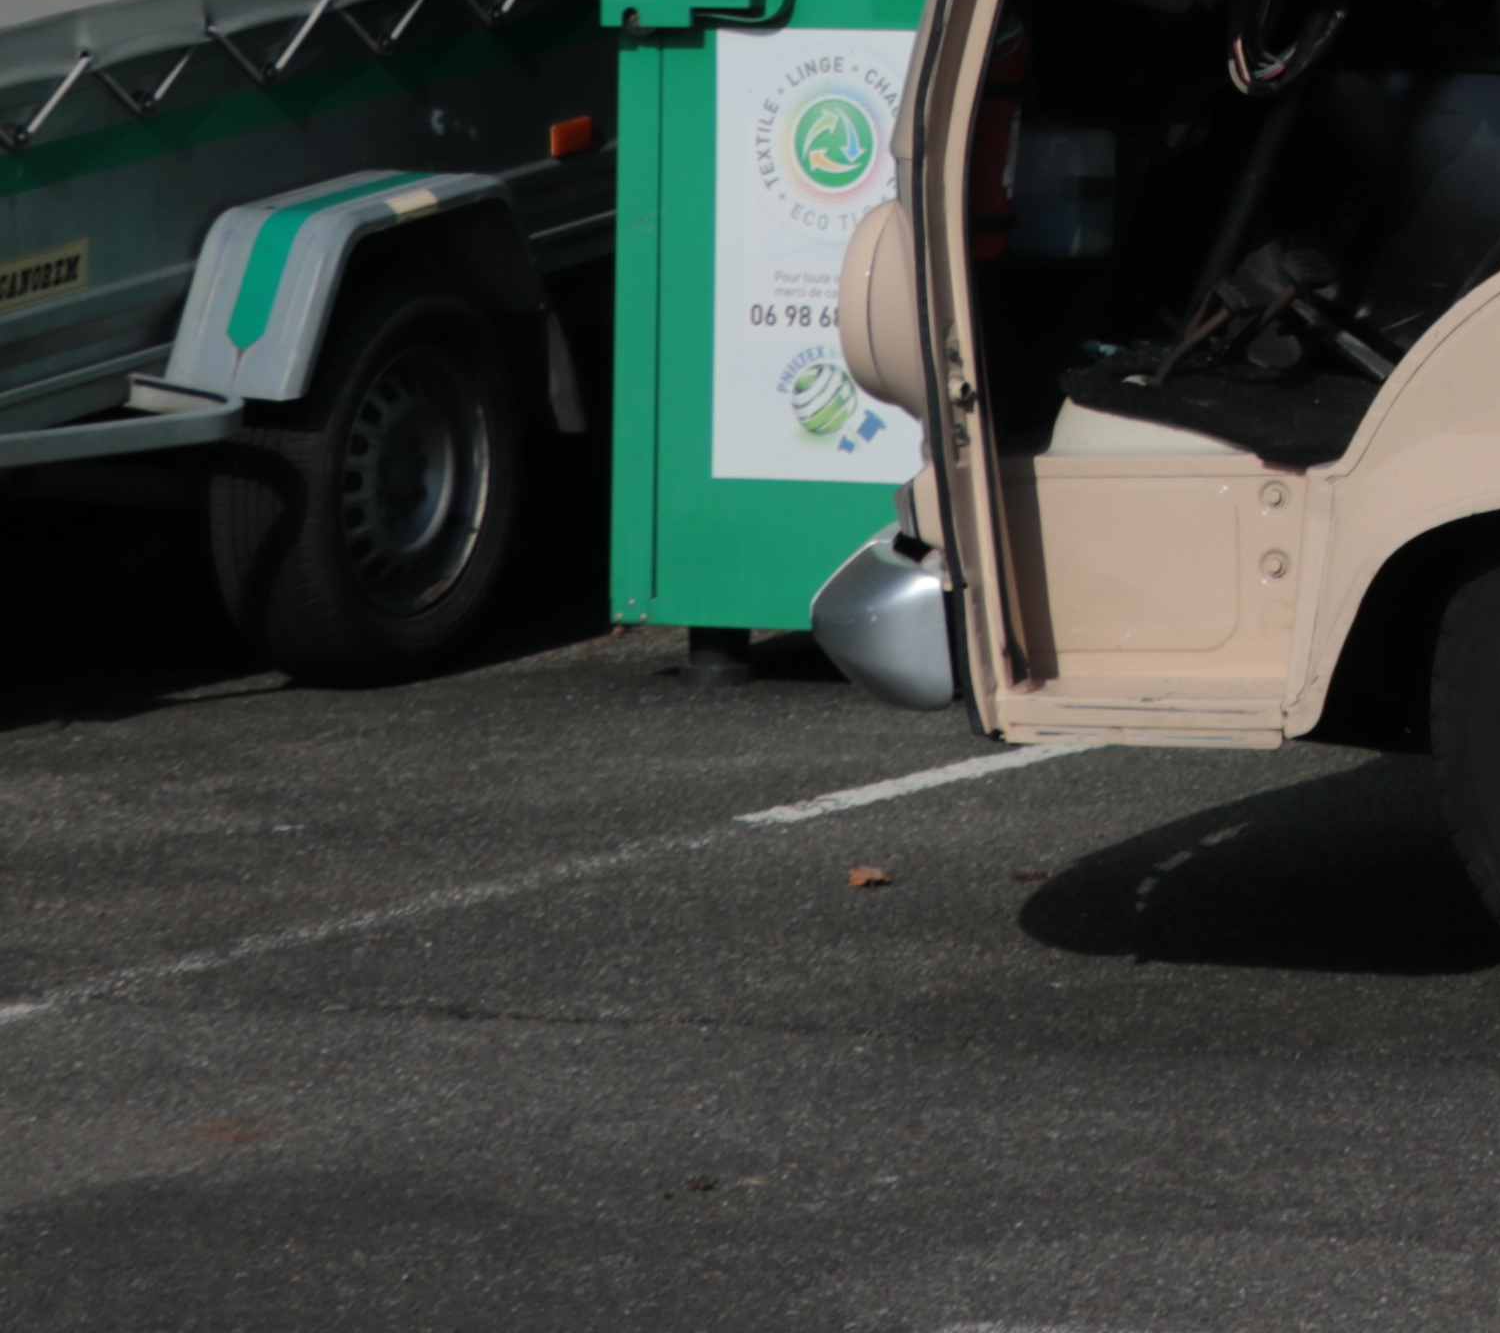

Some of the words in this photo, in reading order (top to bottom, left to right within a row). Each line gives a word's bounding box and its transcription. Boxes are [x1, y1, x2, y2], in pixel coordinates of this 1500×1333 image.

[755, 98, 780, 191] TEXTILE
[785, 55, 845, 88] LINGE
[789, 202, 830, 231] ECO
[774, 271, 801, 283] Pour
[803, 273, 832, 284] toute
[774, 286, 806, 298] merci
[808, 287, 823, 299] de
[751, 304, 777, 326] 06
[785, 305, 812, 328] 98
